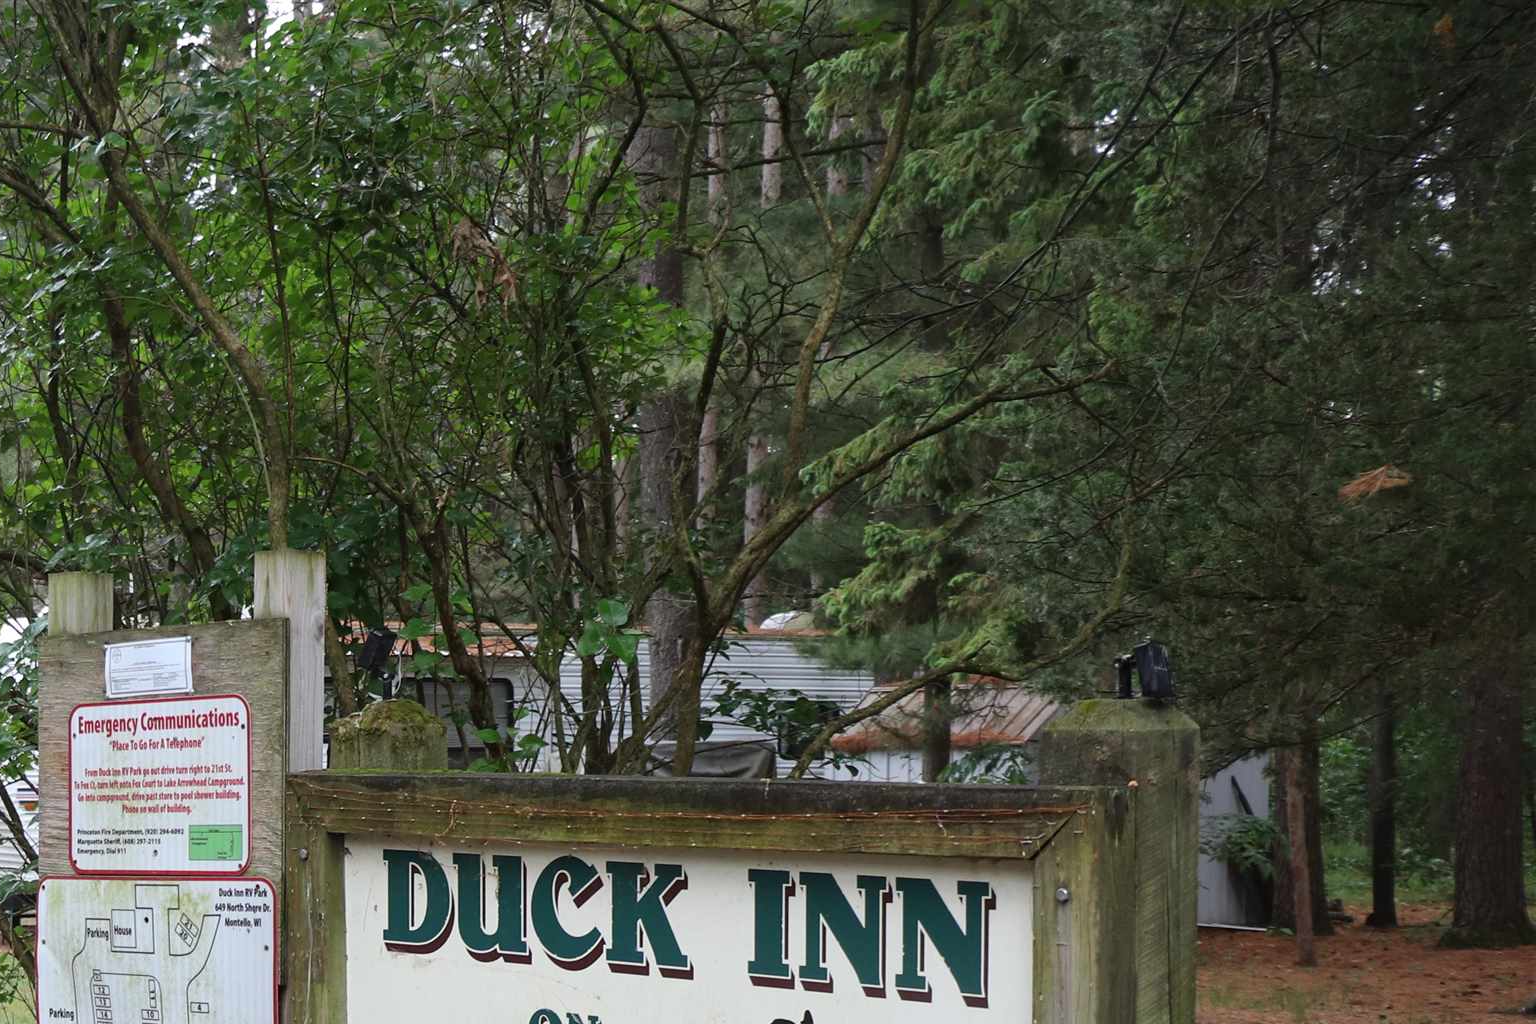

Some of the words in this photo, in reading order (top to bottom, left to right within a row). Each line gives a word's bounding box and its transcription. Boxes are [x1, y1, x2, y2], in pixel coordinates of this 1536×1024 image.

[78, 716, 138, 737] Emergency
[140, 708, 240, 731] Communications
[131, 740, 138, 751] To
[139, 740, 147, 751] Go
[149, 739, 159, 750] For
[160, 738, 165, 749] A
[85, 768, 98, 777] From
[99, 767, 111, 777] Duck
[122, 767, 129, 776] RV
[130, 766, 141, 776] Park
[161, 765, 175, 774] drive
[176, 766, 188, 774] turn
[189, 764, 204, 776] right
[204, 765, 211, 774] to
[157, 779, 163, 788] to
[164, 778, 176, 787] Lake
[177, 777, 207, 787] Arrowhead
[132, 792, 145, 801] drive
[146, 792, 158, 802] past
[159, 791, 173, 800] store
[174, 791, 180, 800] to
[219, 888, 233, 897] Duck
[234, 888, 244, 897] Inn
[245, 888, 253, 897] RV
[254, 888, 268, 897] Park
[215, 903, 226, 912] 649
[227, 903, 243, 912] North
[245, 903, 261, 913] Shore
[263, 904, 272, 913] Dr.
[225, 918, 253, 928] Montello,
[254, 918, 262, 927] WI
[382, 848, 695, 981] DUCK
[747, 868, 997, 1009] INN
[87, 927, 109, 941] Parking
[113, 925, 132, 936] House
[49, 1008, 75, 1021] Parking
